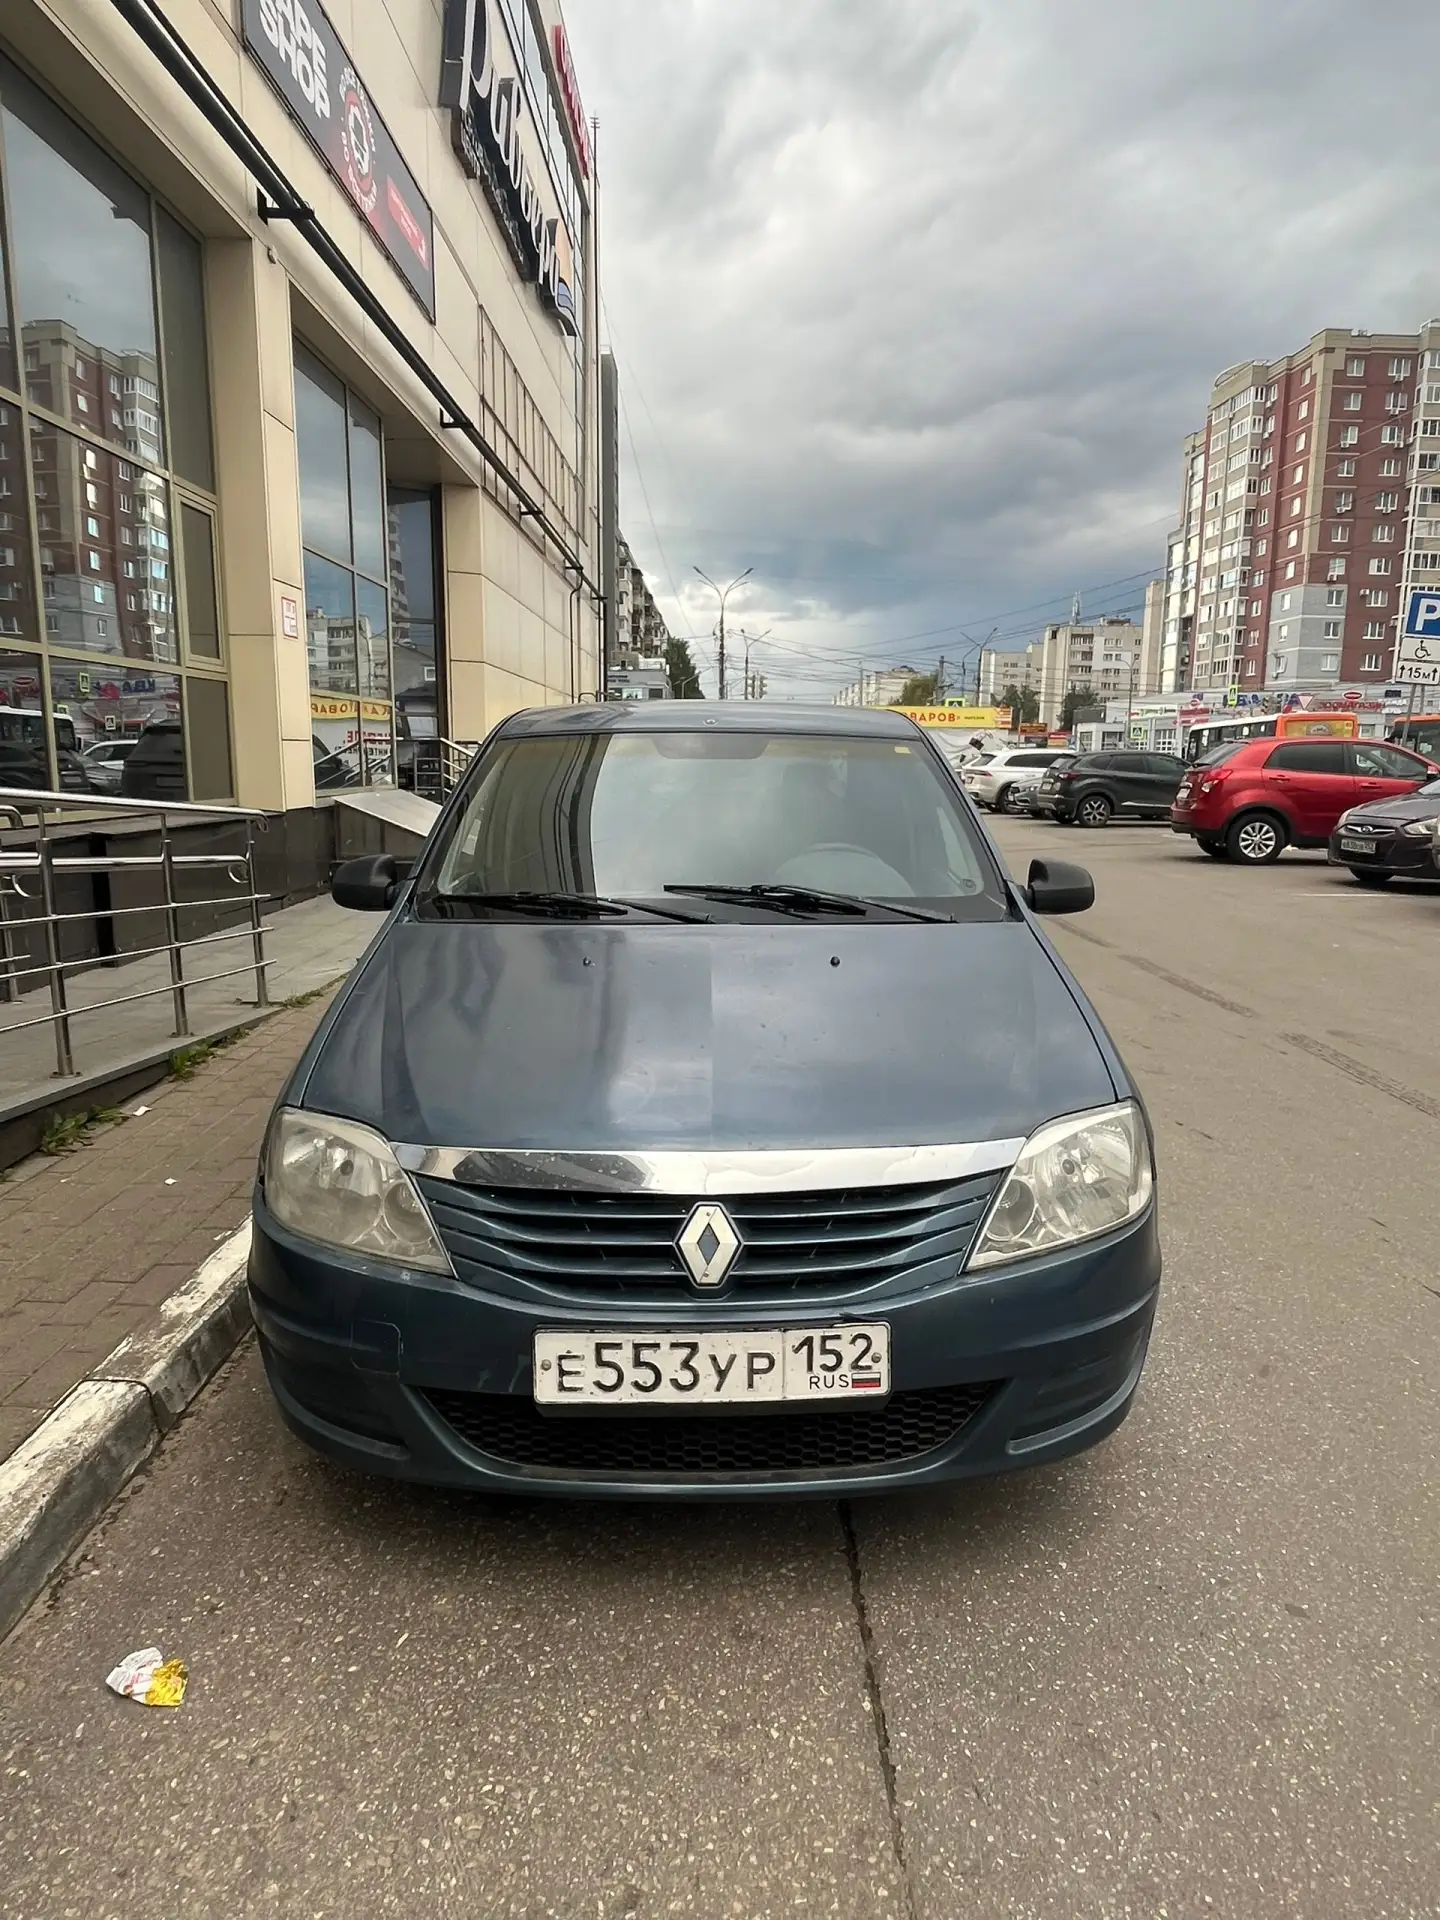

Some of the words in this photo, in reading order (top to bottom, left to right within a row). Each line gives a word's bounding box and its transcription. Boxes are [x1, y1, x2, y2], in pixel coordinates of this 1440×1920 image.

[260, 0, 330, 119] SHOP
[1415, 598, 1440, 631] P
[556, 1341, 776, 1393] Е553УР
[791, 1333, 875, 1373] 152
[809, 1374, 849, 1390] RUS
